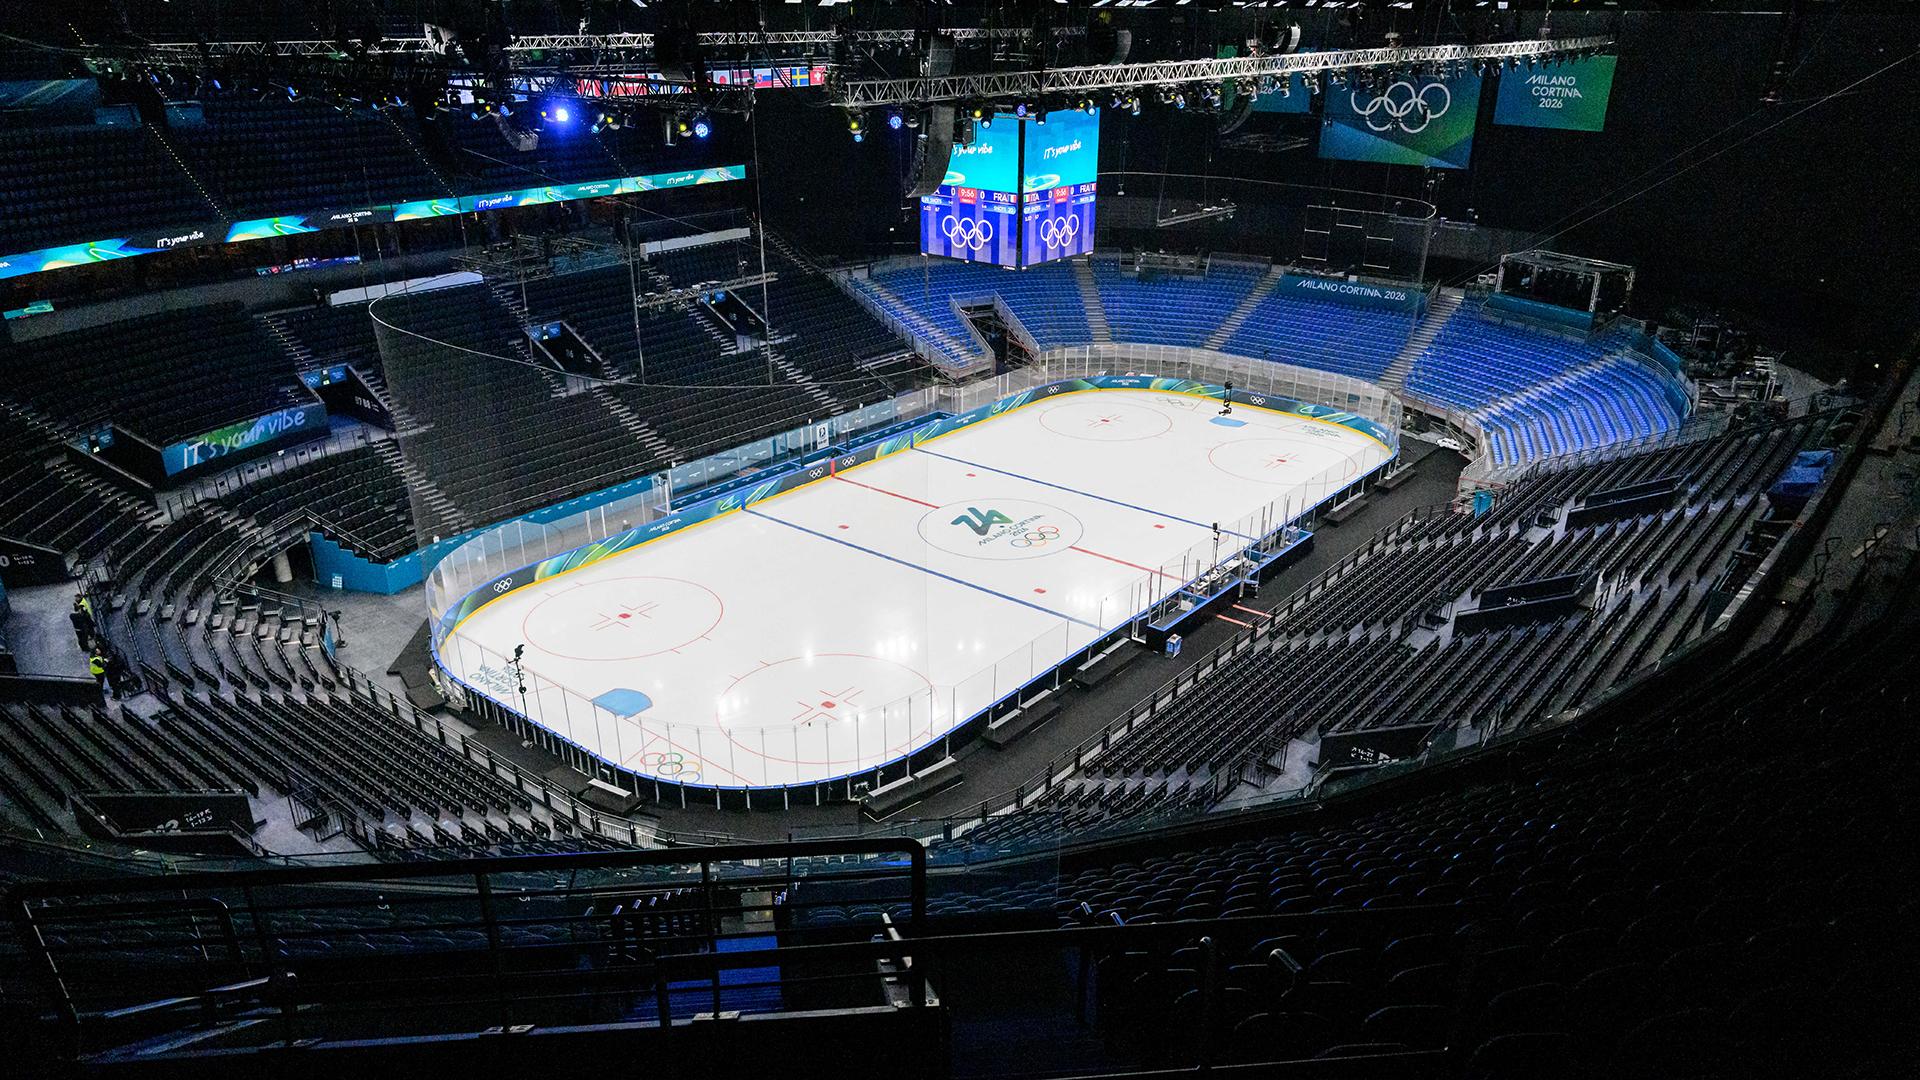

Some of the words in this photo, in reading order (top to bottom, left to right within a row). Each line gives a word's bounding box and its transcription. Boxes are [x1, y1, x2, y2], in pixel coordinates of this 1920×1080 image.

[1525, 75, 1576, 86] MILANO
[1532, 86, 1583, 98] CORTINA
[1539, 98, 1563, 109] 2026
[951, 187, 956, 196] 0
[961, 189, 975, 198] 9:56
[980, 191, 985, 199] 0
[993, 193, 1008, 202] FRA
[1048, 190, 1053, 199] 0
[1070, 186, 1075, 195] 0
[157, 239, 170, 248] IT's
[171, 235, 188, 247] your
[189, 231, 204, 241] vibe
[1297, 279, 1338, 292] MILANO
[1339, 284, 1382, 298] CORTINA
[1384, 290, 1406, 301] 2026
[183, 438, 217, 469] IT's
[221, 424, 265, 456] your
[268, 410, 306, 435] vibe
